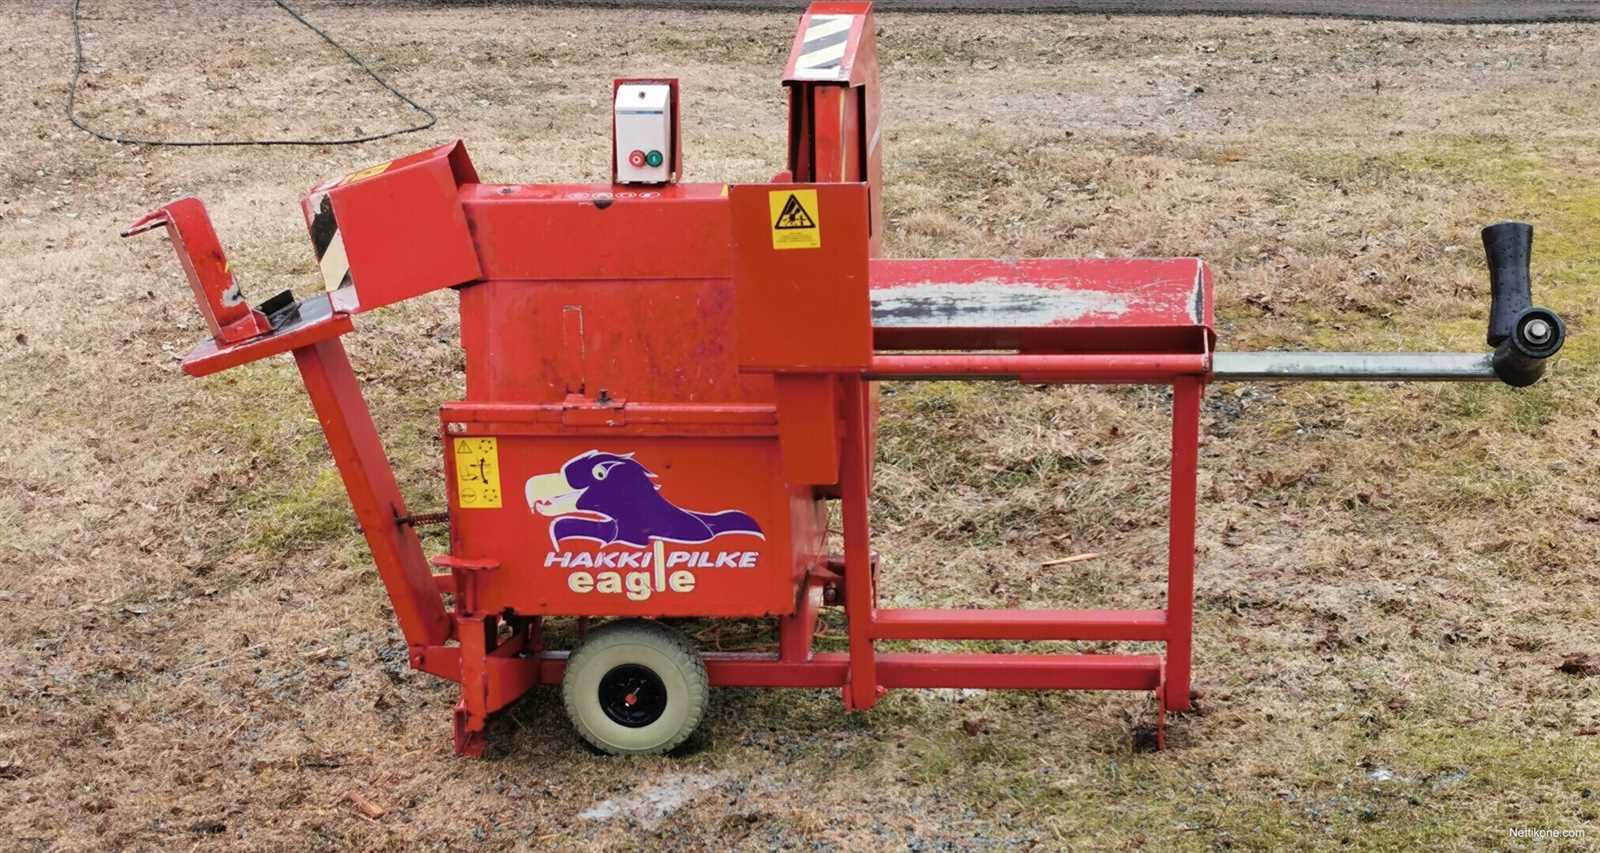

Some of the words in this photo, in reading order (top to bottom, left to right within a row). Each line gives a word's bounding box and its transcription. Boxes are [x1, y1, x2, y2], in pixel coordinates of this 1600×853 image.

[543, 551, 653, 568] HAKKI
[666, 551, 759, 568] PILKE
[567, 540, 696, 601] eagle
